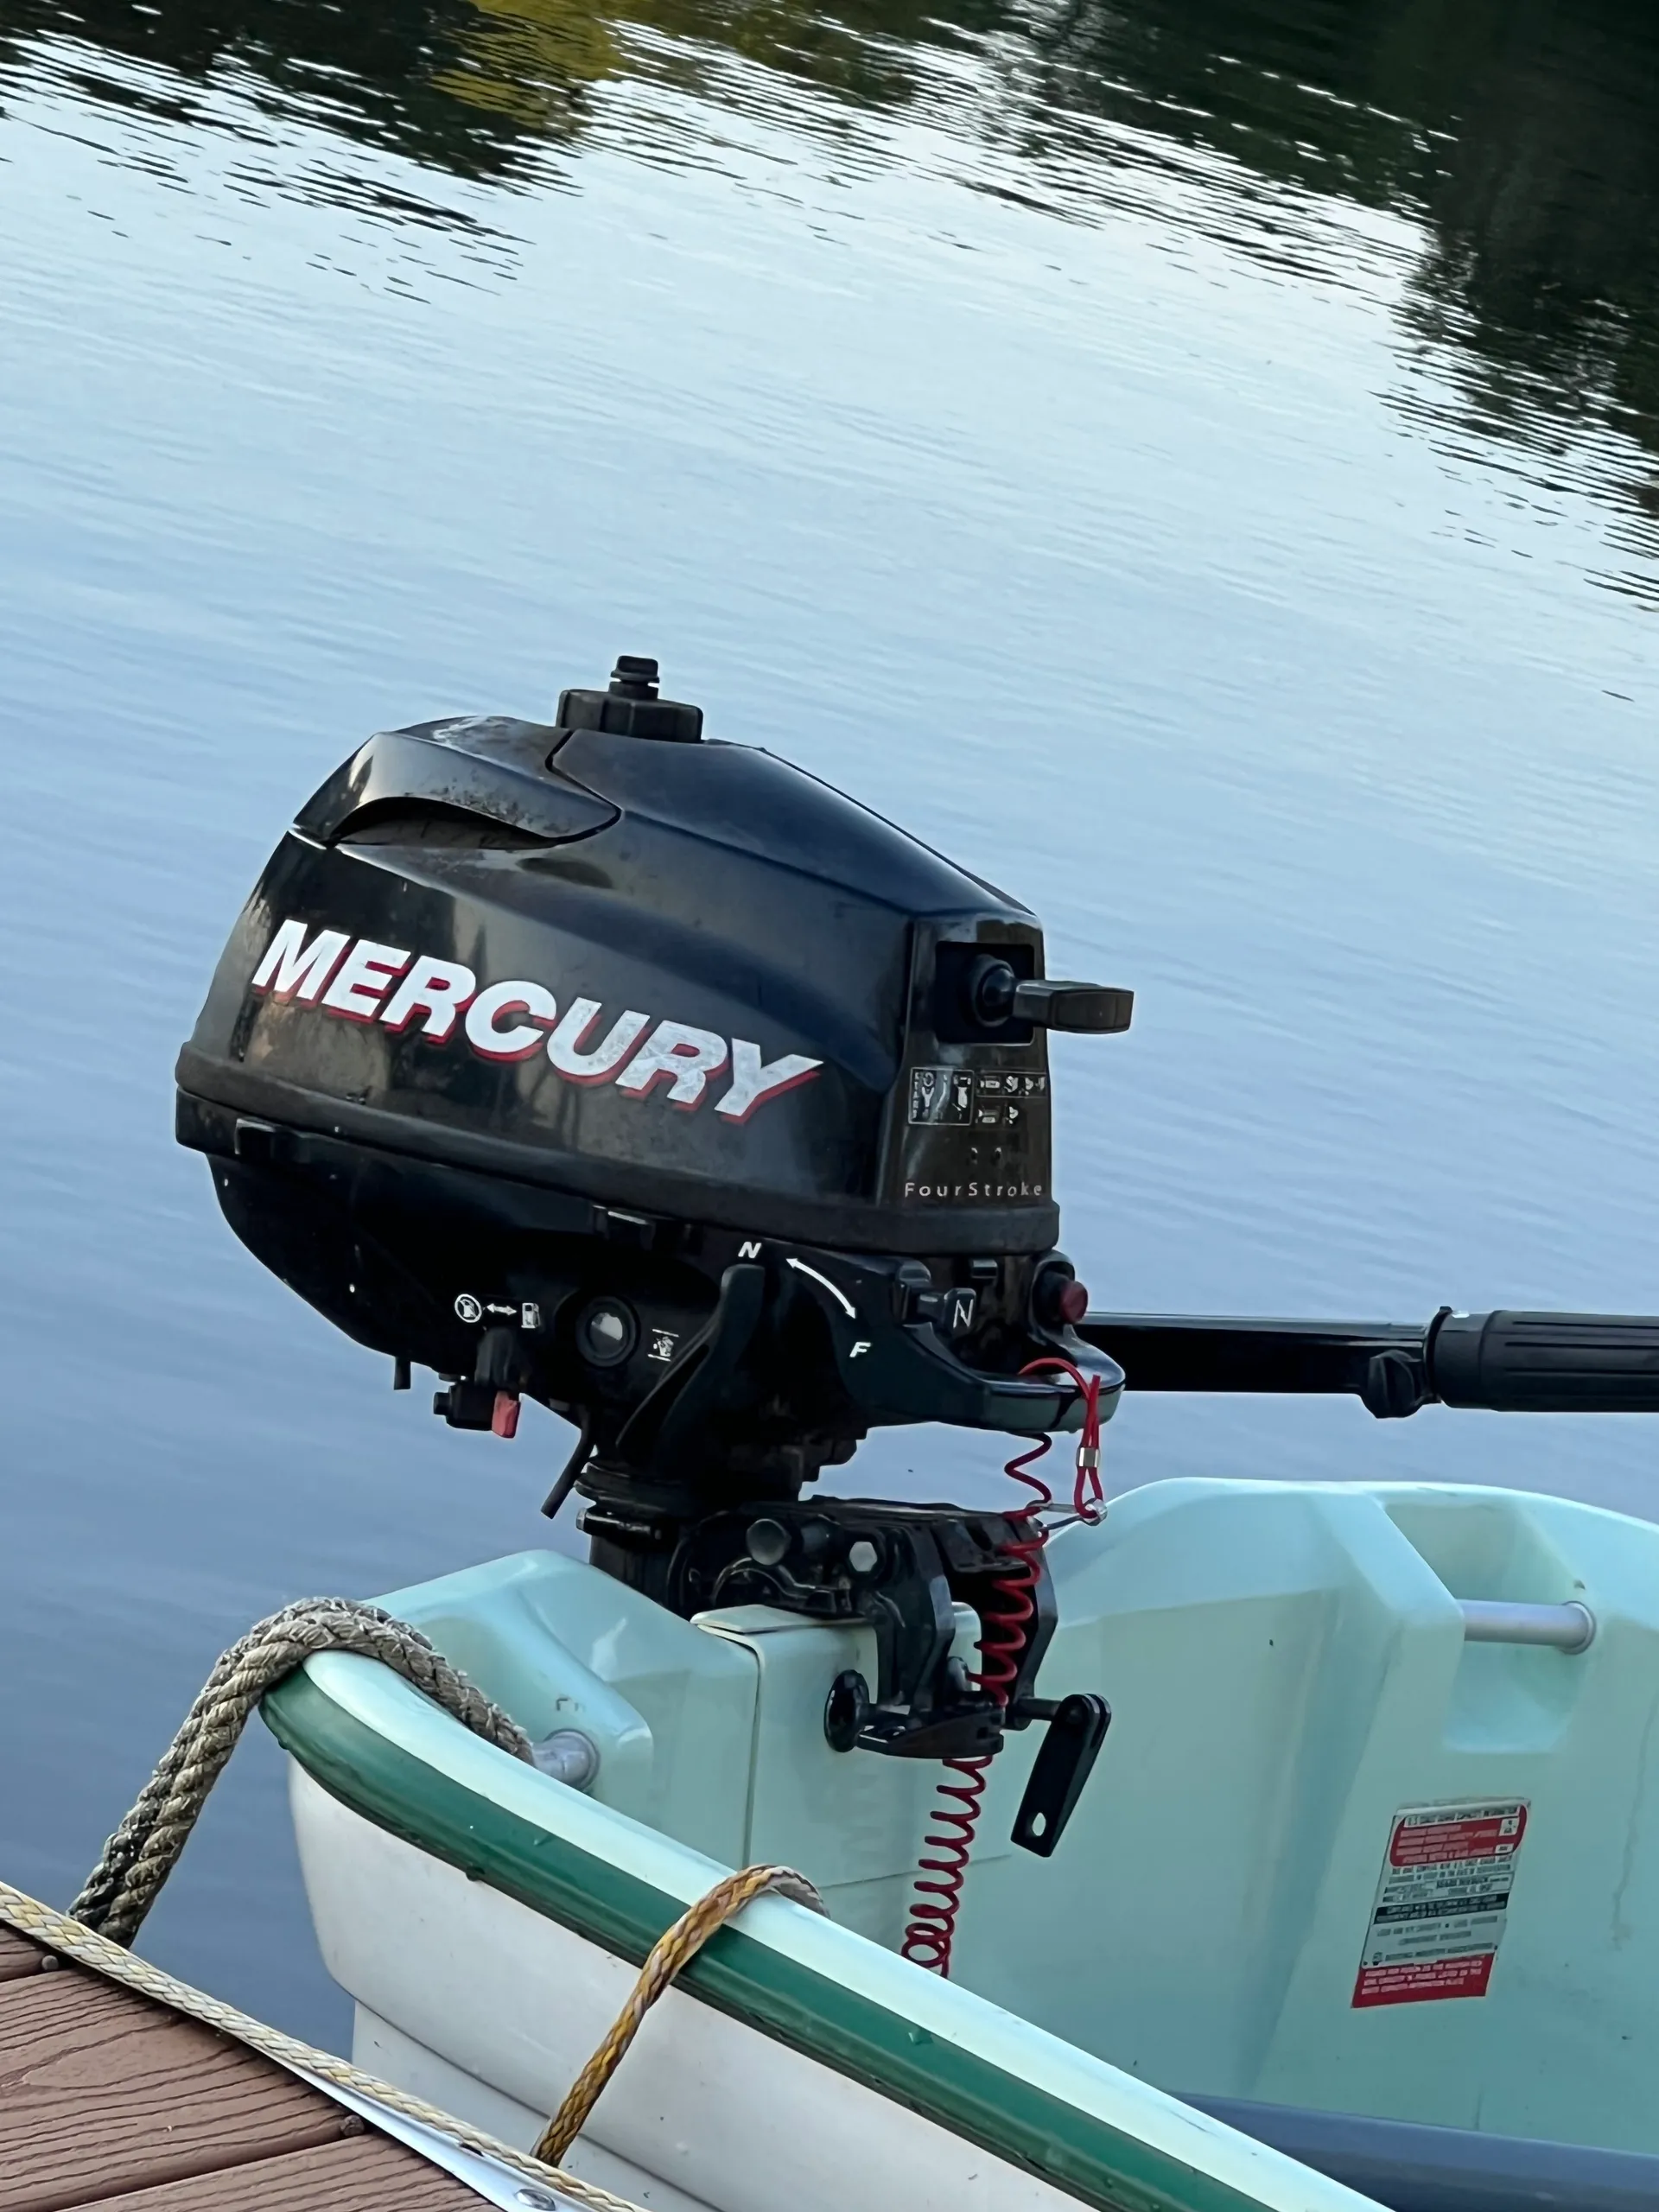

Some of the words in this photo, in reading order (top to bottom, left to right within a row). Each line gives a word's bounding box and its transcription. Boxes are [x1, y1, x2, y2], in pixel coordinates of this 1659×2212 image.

[251, 919, 824, 1122] MERCURY
[905, 1181, 1042, 1198] FourStroke
[738, 1241, 761, 1259] N
[953, 1299, 974, 1329] N
[849, 1341, 872, 1357] F
